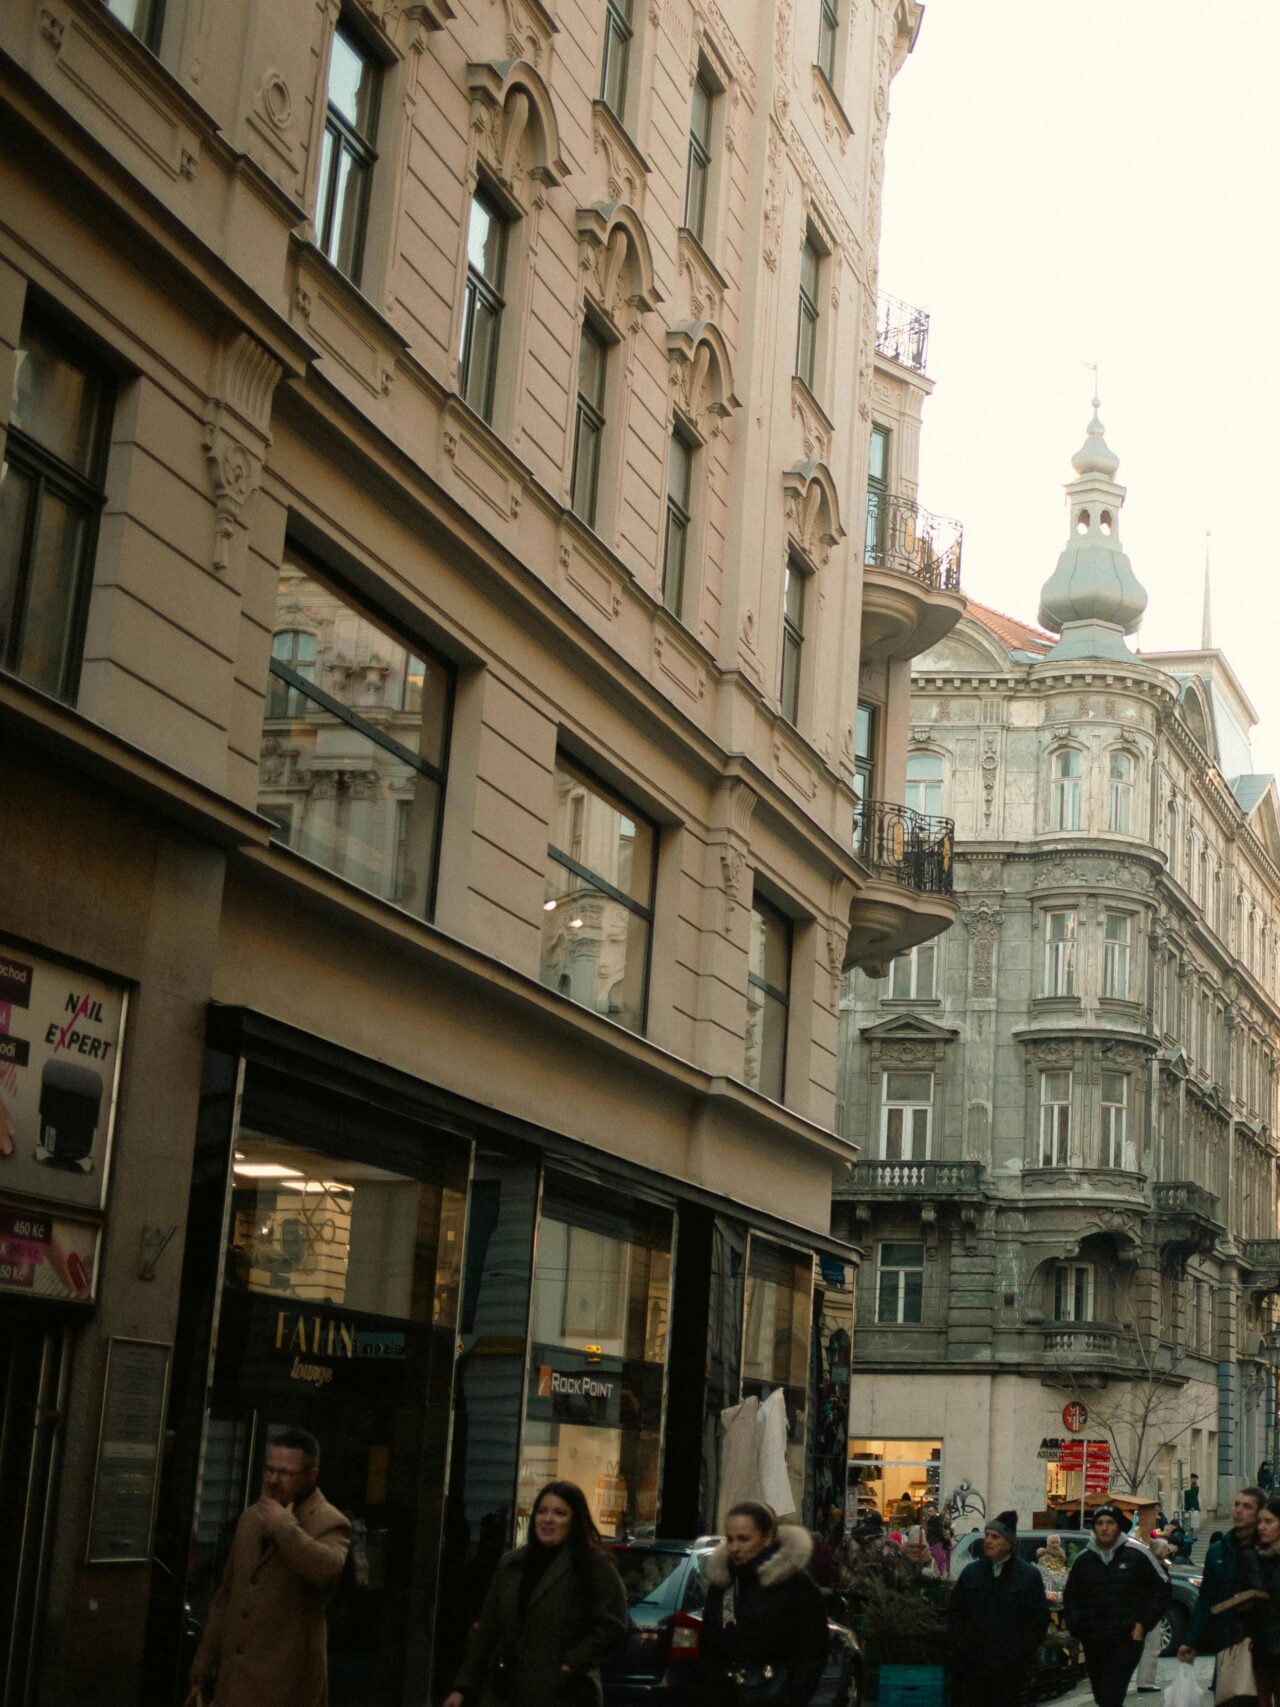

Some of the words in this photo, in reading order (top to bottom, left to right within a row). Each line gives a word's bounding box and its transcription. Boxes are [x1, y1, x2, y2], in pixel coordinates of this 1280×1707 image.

[64, 993, 103, 1023] NAIL
[45, 1023, 112, 1060] EXPERT
[13, 1220, 31, 1236] 450
[32, 1223, 45, 1239] Kč
[274, 1311, 355, 1358] FATIN
